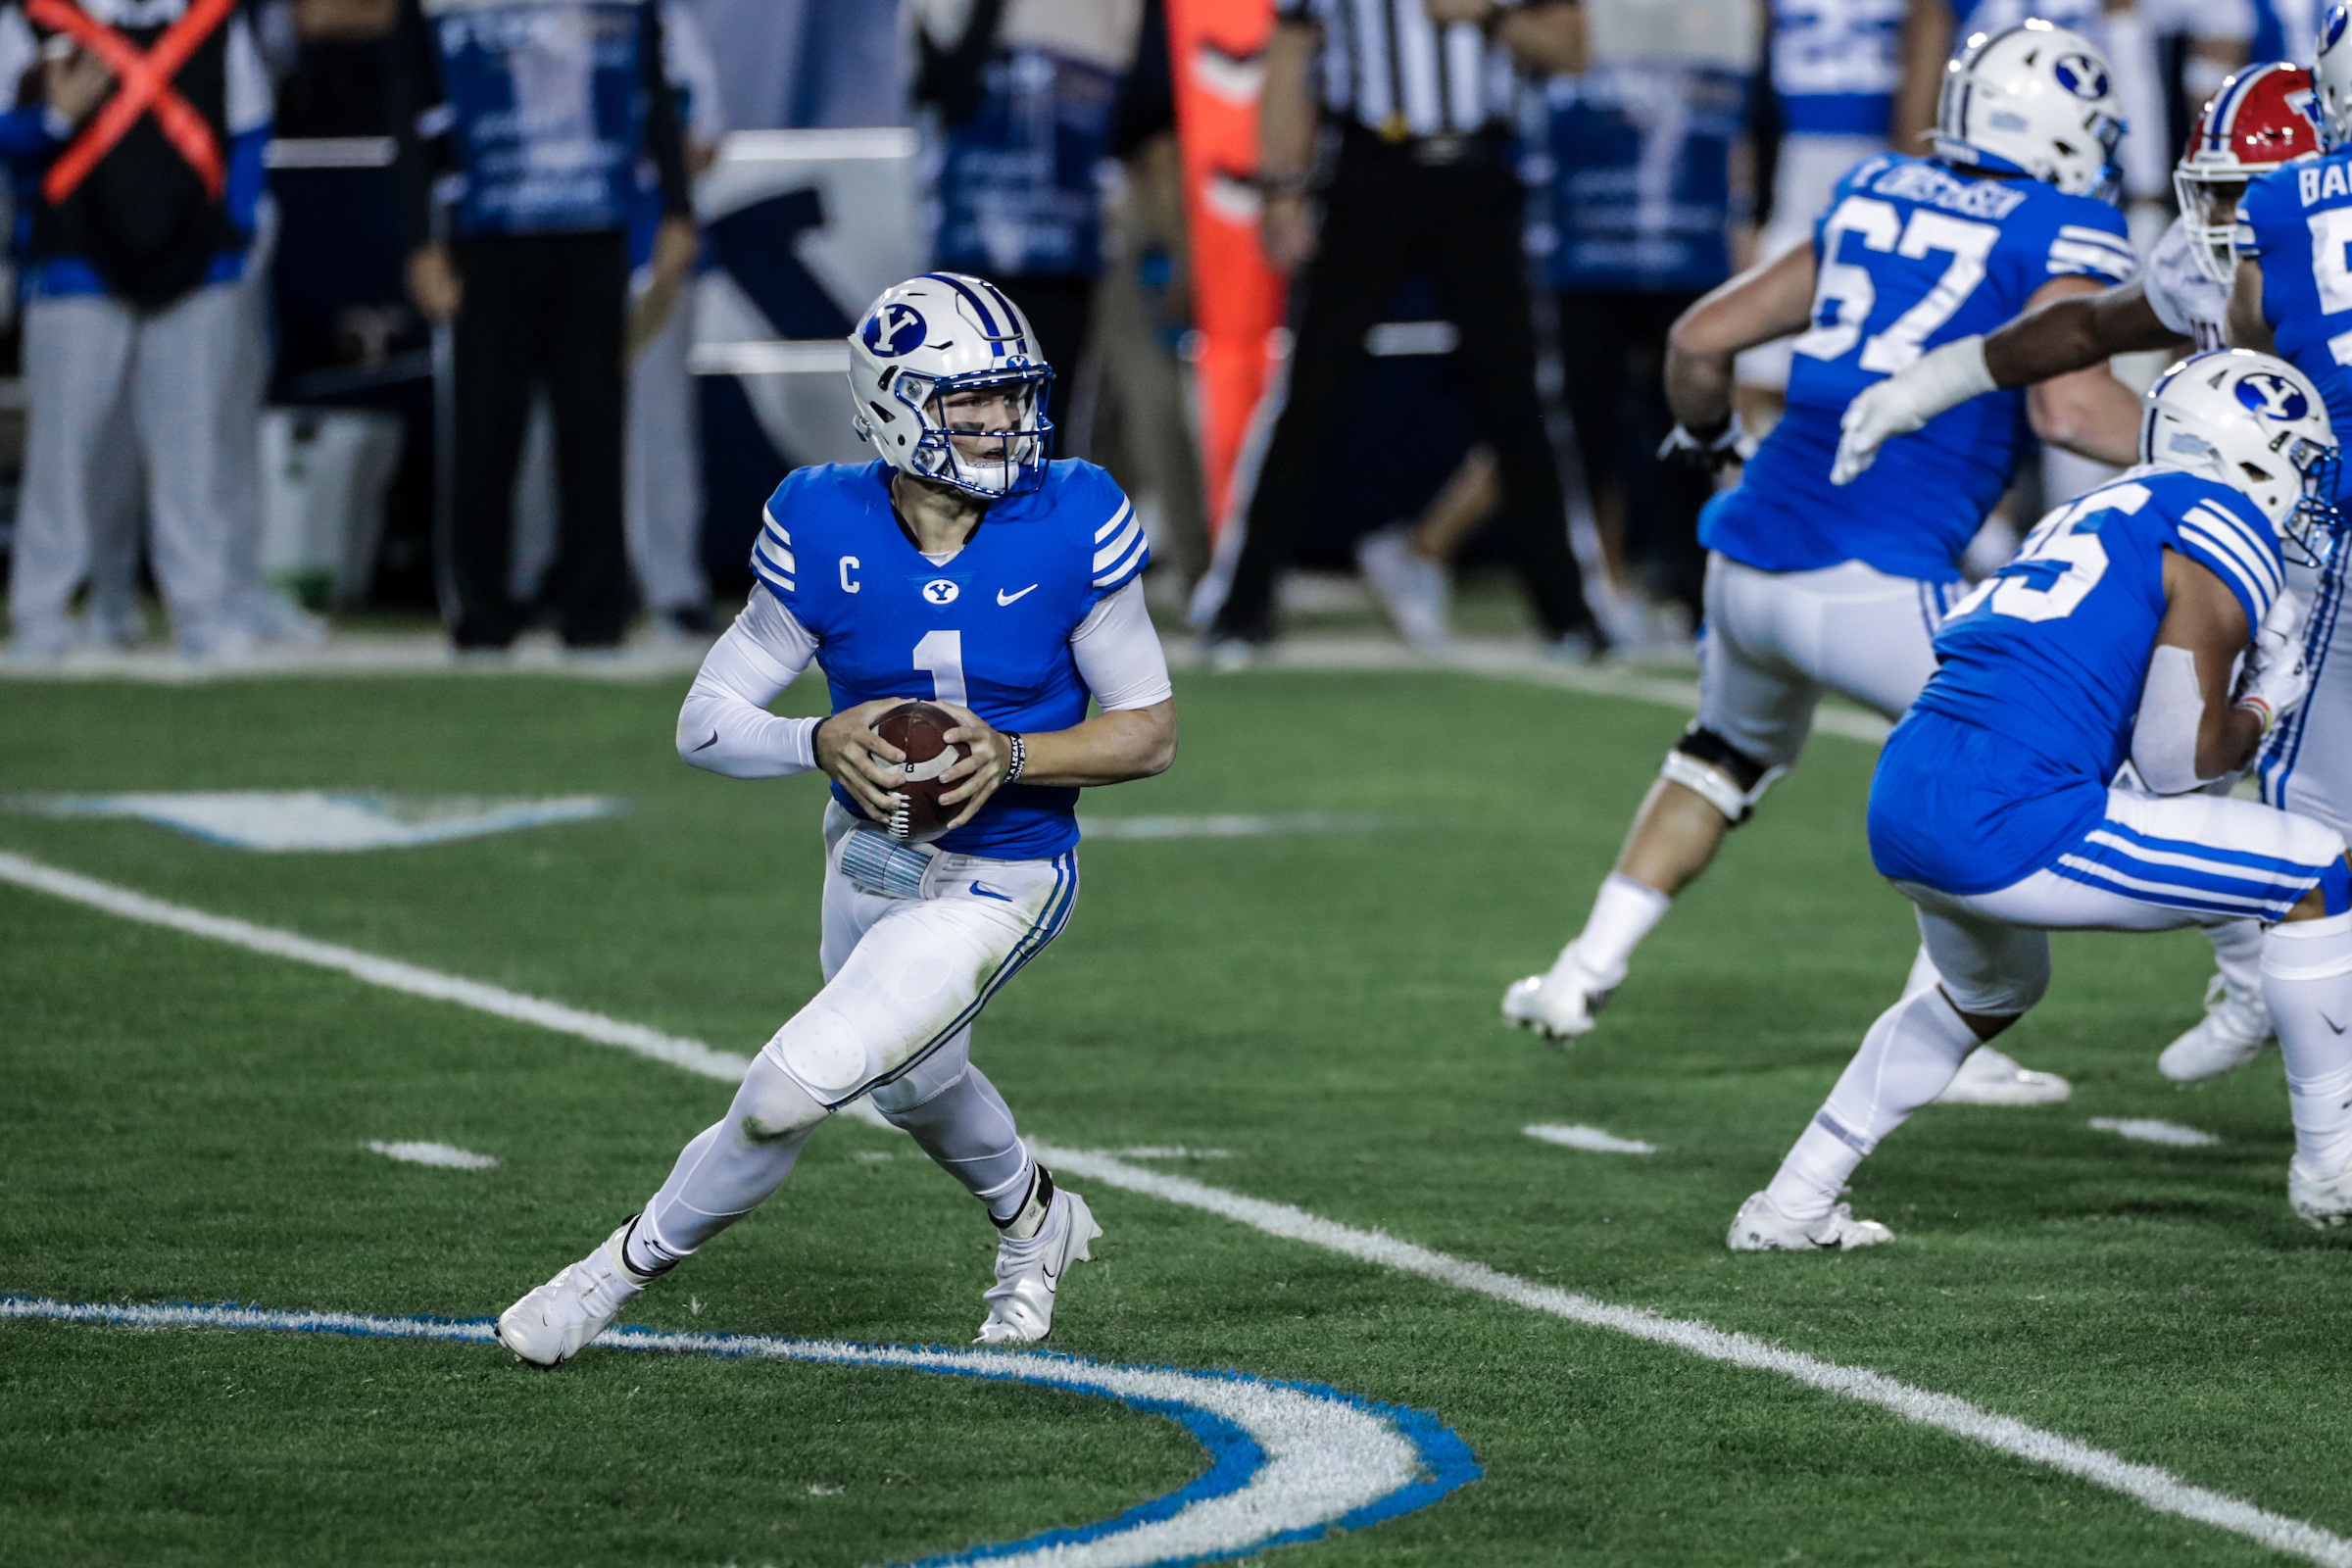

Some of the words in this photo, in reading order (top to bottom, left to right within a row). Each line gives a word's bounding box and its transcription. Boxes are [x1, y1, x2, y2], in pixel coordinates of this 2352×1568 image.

[2298, 160, 2352, 208] BA
[1791, 195, 2001, 374] 67
[873, 306, 919, 352] Y
[2243, 374, 2301, 417] Y
[839, 555, 860, 594] C
[912, 629, 968, 709] 1
[1010, 735, 1019, 766] LEGACY
